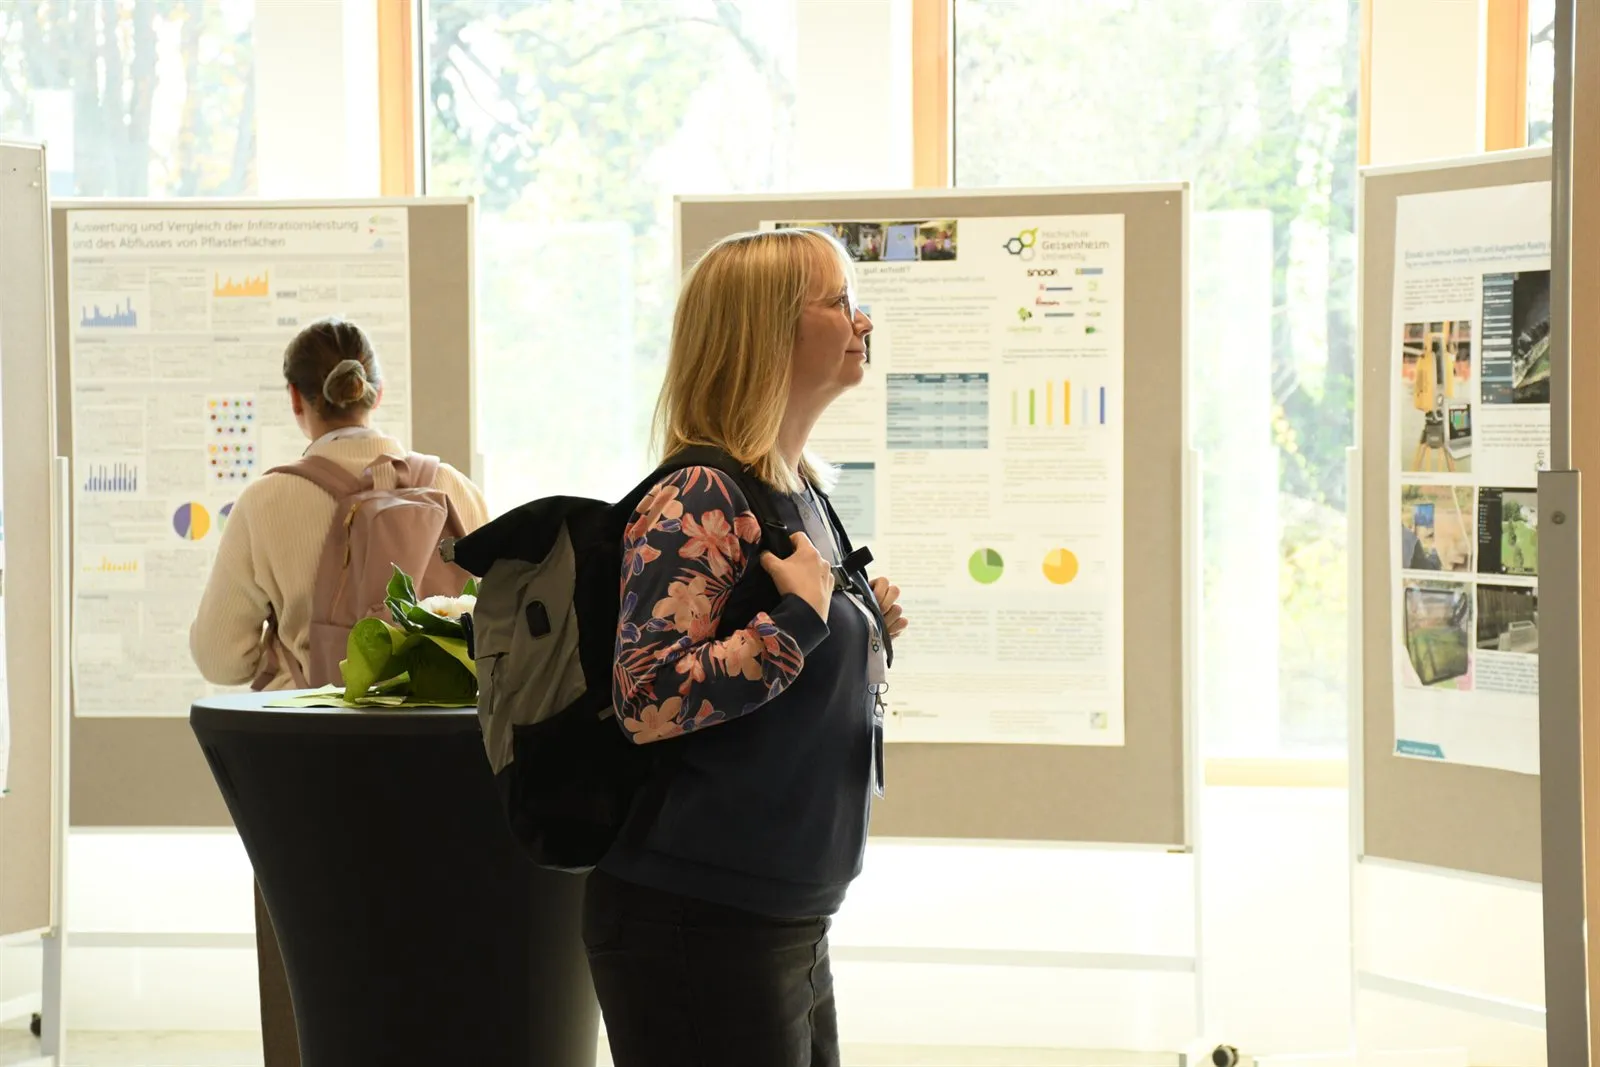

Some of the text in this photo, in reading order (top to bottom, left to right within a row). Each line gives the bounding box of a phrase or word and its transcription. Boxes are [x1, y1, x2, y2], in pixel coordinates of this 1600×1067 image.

[73, 219, 359, 234] Auswertung und Vergleich der Infiltrationsleistung
[1042, 230, 1089, 239] Hochschule
[73, 237, 286, 249] und des Abflusses von Pflasterflächen
[1042, 240, 1110, 251] Geisenheim
